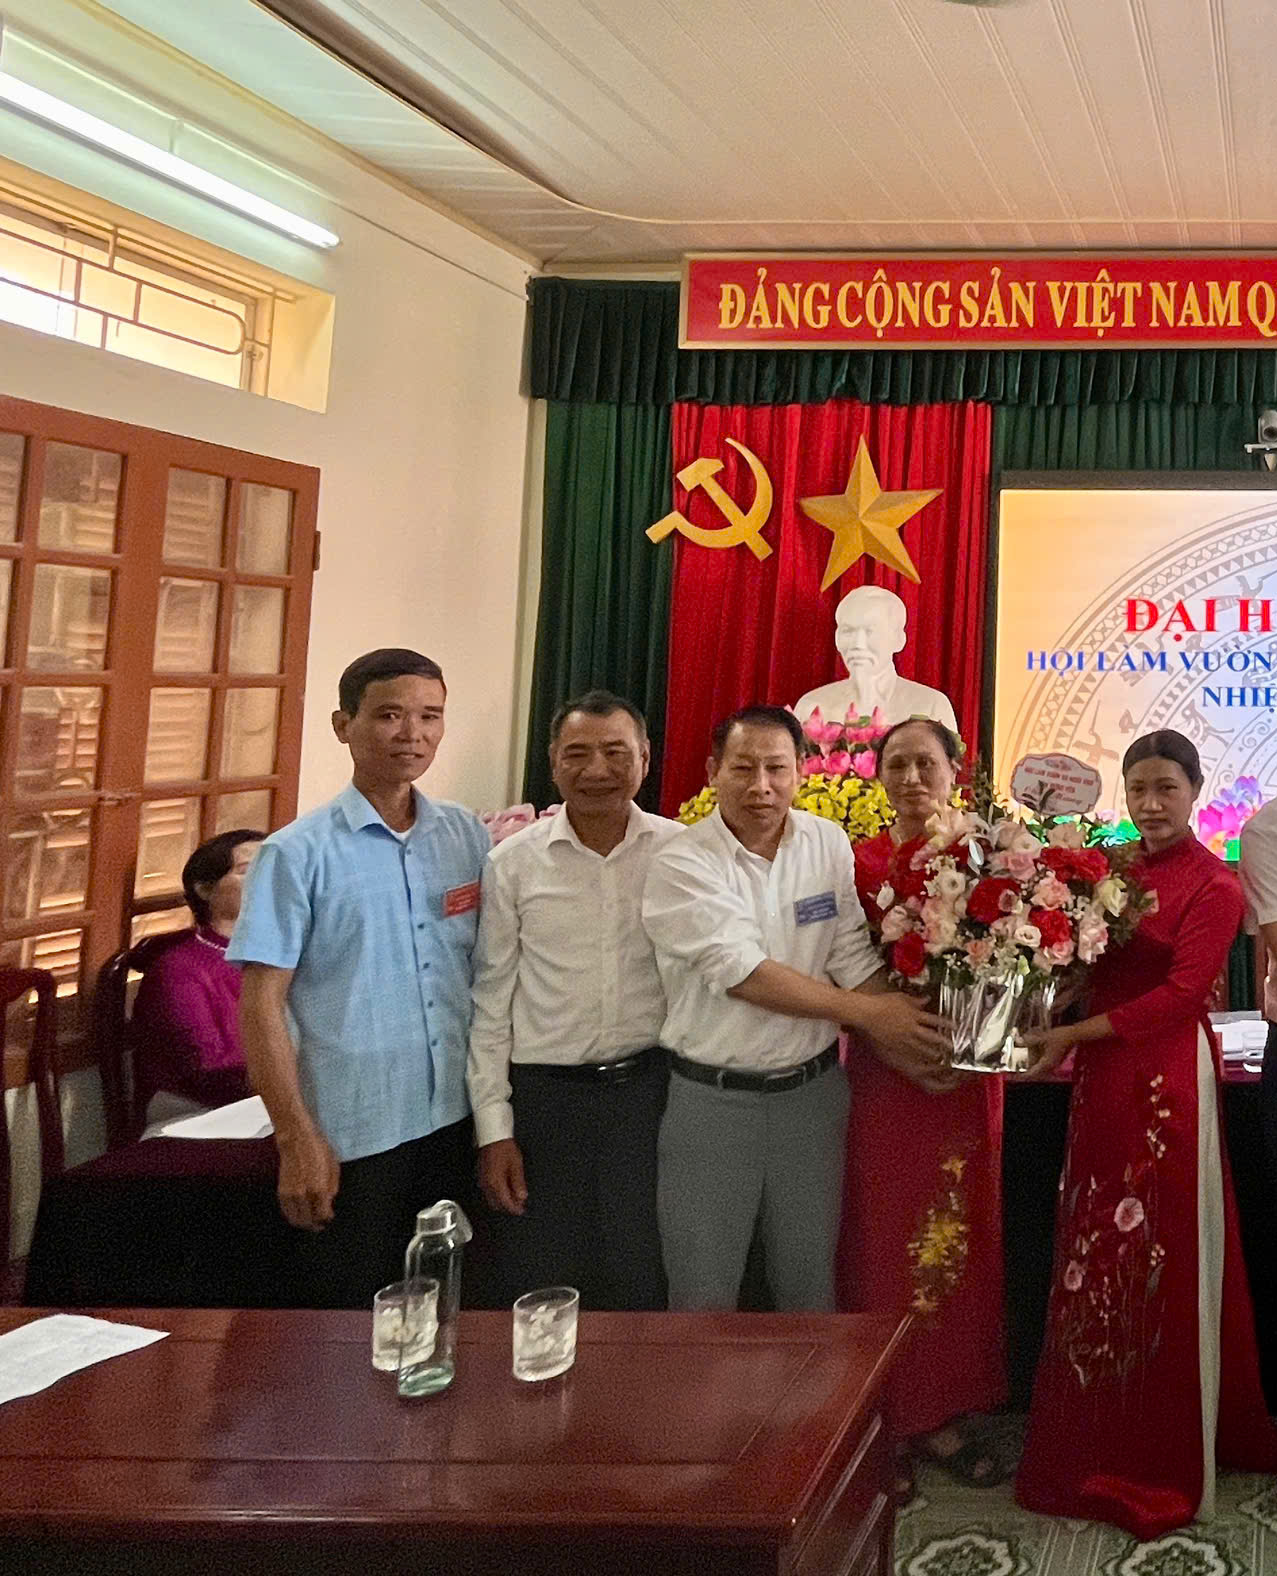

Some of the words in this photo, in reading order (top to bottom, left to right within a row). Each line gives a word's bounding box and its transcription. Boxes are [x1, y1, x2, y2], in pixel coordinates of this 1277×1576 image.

[719, 267, 831, 328] ĐẢNG
[837, 268, 952, 338] CỘNG
[959, 266, 1035, 328] SẢN
[1046, 269, 1141, 337] VIỆT
[1149, 281, 1242, 327] NAM
[1122, 598, 1219, 642] ĐẠI
